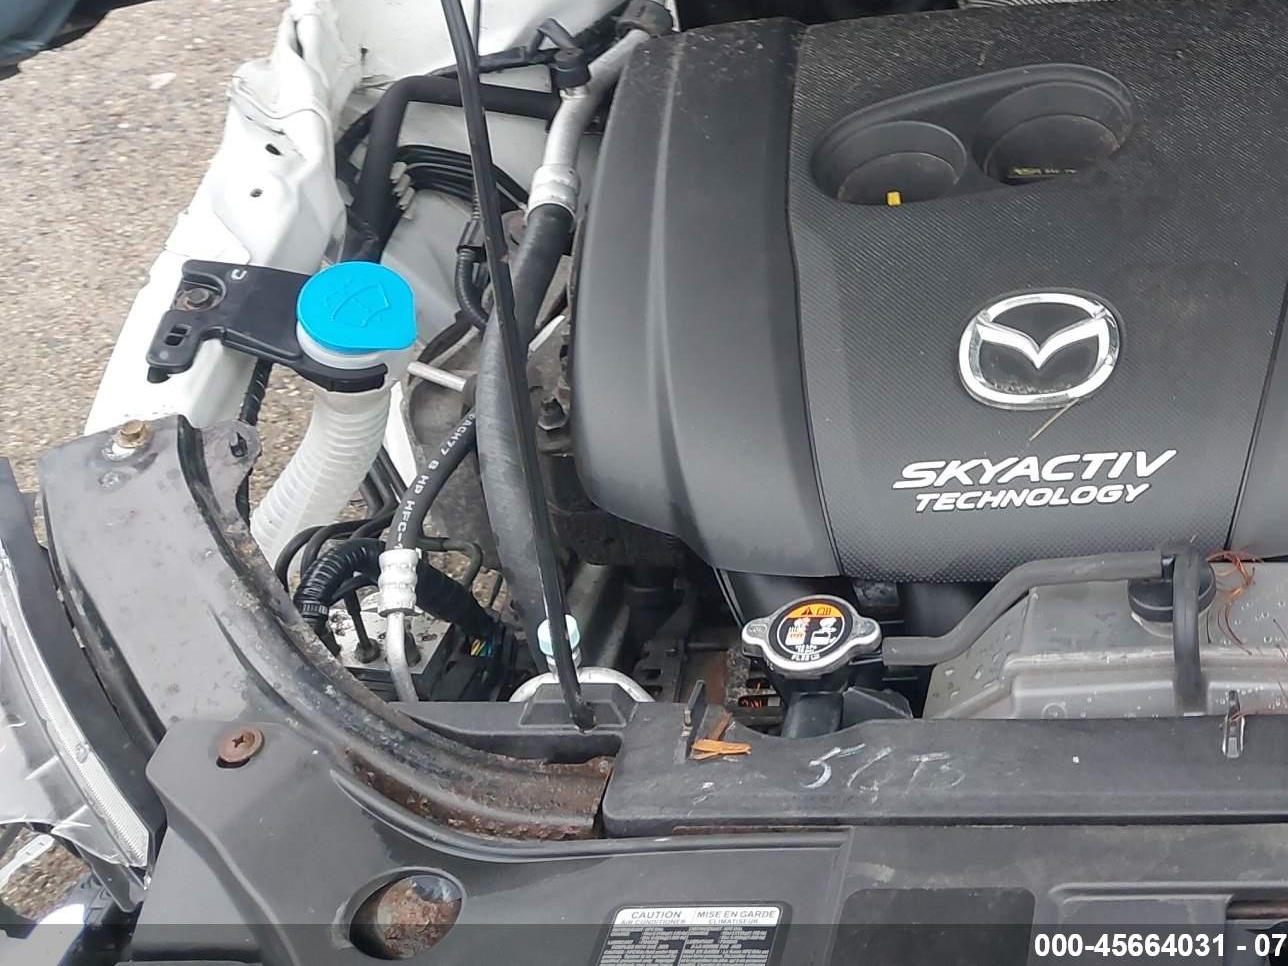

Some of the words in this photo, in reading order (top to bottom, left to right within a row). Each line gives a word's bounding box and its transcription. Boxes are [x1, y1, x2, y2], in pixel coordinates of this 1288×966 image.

[892, 449, 1177, 489] SKYACTIV
[915, 483, 1150, 512] TECHNOLOGY
[631, 910, 682, 920] CAUTION
[696, 910, 721, 919] MISE
[723, 910, 739, 919] EN
[740, 910, 777, 919] GARDE
